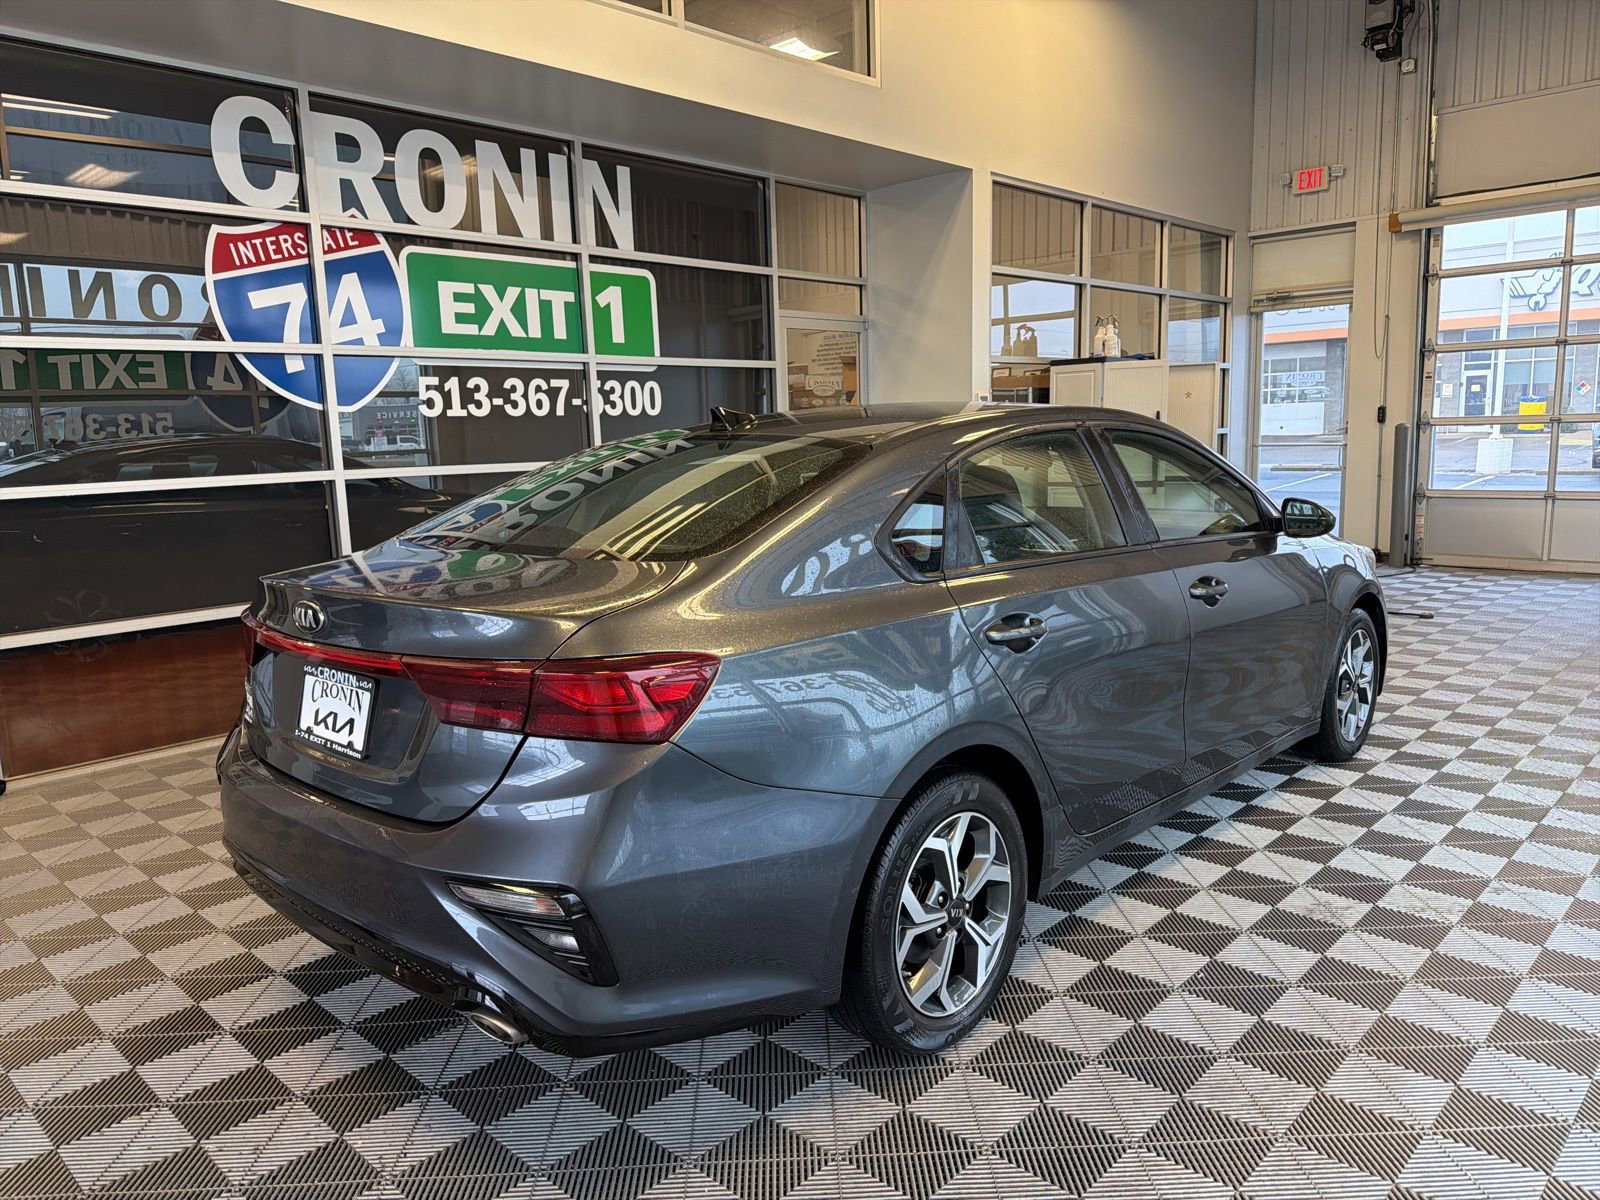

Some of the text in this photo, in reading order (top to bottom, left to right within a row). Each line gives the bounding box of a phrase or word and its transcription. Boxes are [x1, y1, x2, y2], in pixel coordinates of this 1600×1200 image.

[210, 95, 636, 252] CRONIN
[1297, 167, 1324, 190] EXIT
[229, 229, 360, 266] INTERSATE
[248, 272, 386, 375] 74
[437, 280, 626, 344] EXIT 1
[418, 376, 662, 417] 513-367-5300
[295, 606, 317, 629] KIA
[317, 666, 357, 687] CRONIN
[311, 678, 366, 716] CRONIN
[313, 706, 357, 738] KIA
[309, 734, 326, 745] EXIT
[332, 742, 362, 760] Harrison
